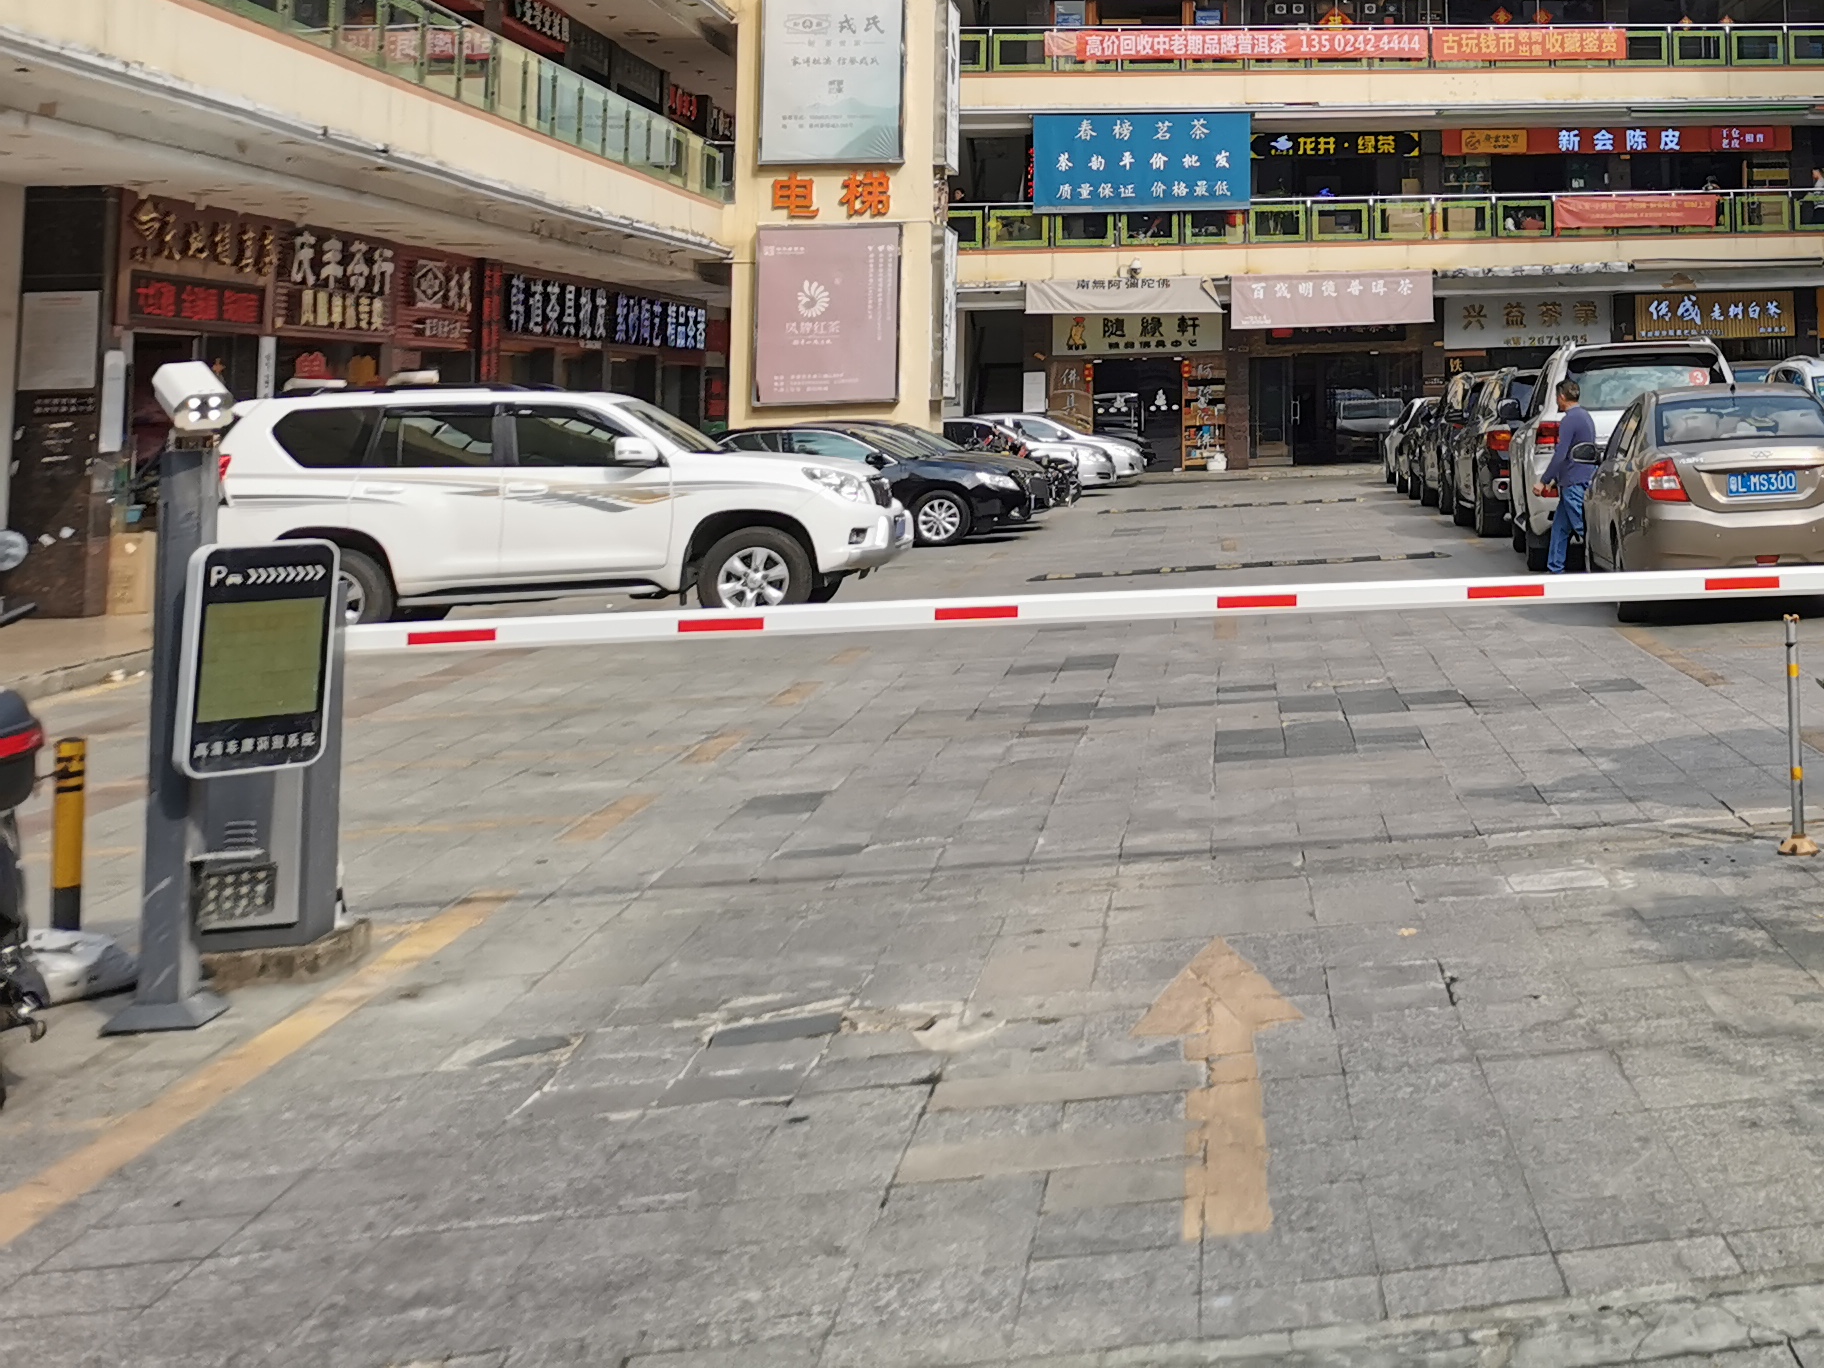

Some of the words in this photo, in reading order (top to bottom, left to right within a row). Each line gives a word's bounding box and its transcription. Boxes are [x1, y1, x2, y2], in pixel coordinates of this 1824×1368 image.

[1085, 34, 1287, 56] 高价回收中老期品牌普洱茶
[1379, 33, 1421, 50] 4444
[1441, 32, 1515, 54] 古玩钱币
[1297, 135, 1396, 155] 龙井·绿茶
[1557, 130, 1681, 151] 新会陈皮
[772, 172, 892, 218] 电梯
